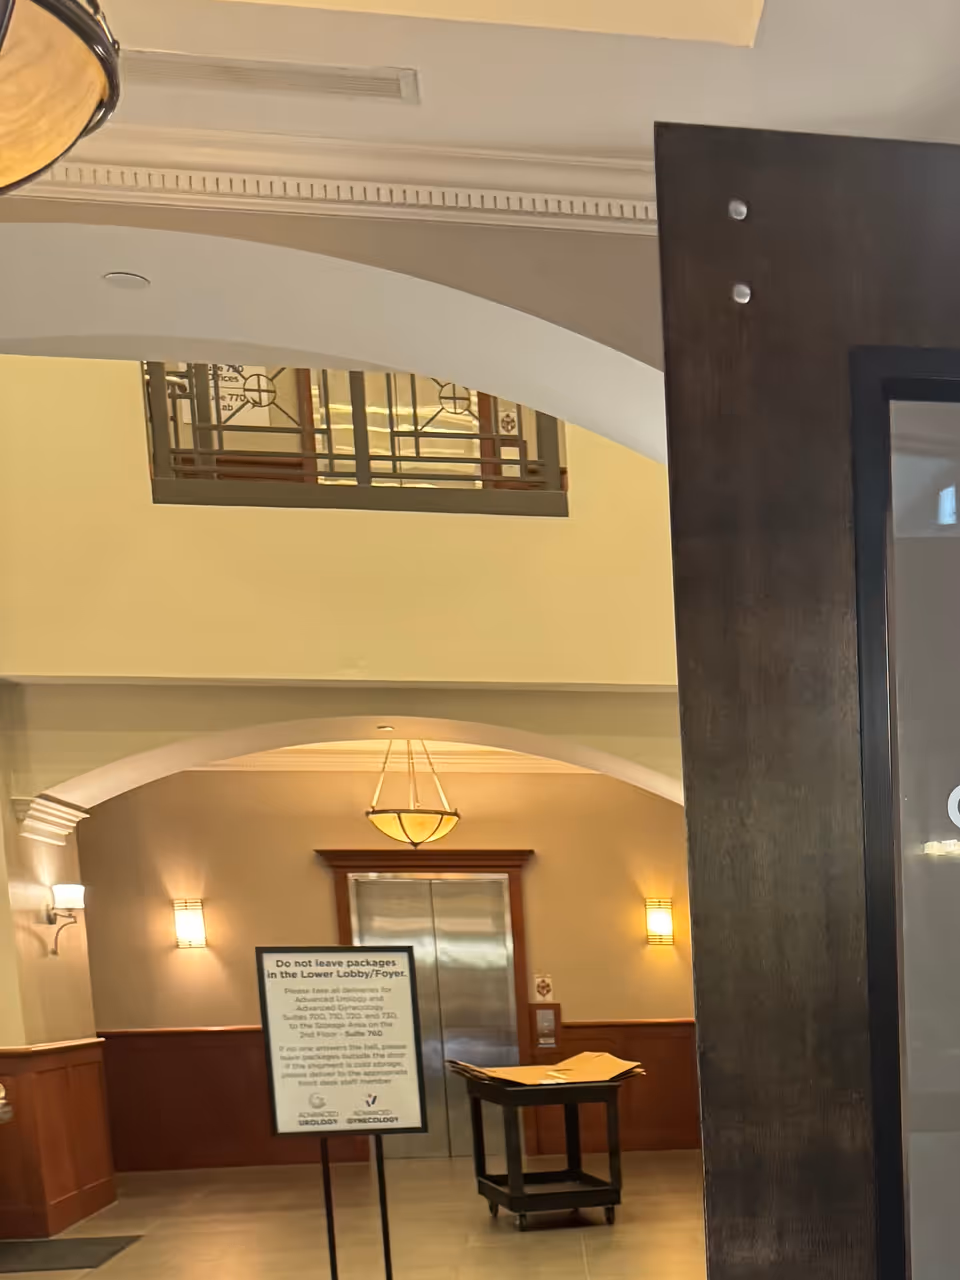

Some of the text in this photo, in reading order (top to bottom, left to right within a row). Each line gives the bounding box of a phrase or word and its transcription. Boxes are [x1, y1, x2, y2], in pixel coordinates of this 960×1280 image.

[276, 959, 396, 969] Do not leave packages
[267, 970, 277, 978] in
[280, 970, 298, 978] the
[337, 969, 408, 979] Lobby/Foyer.
